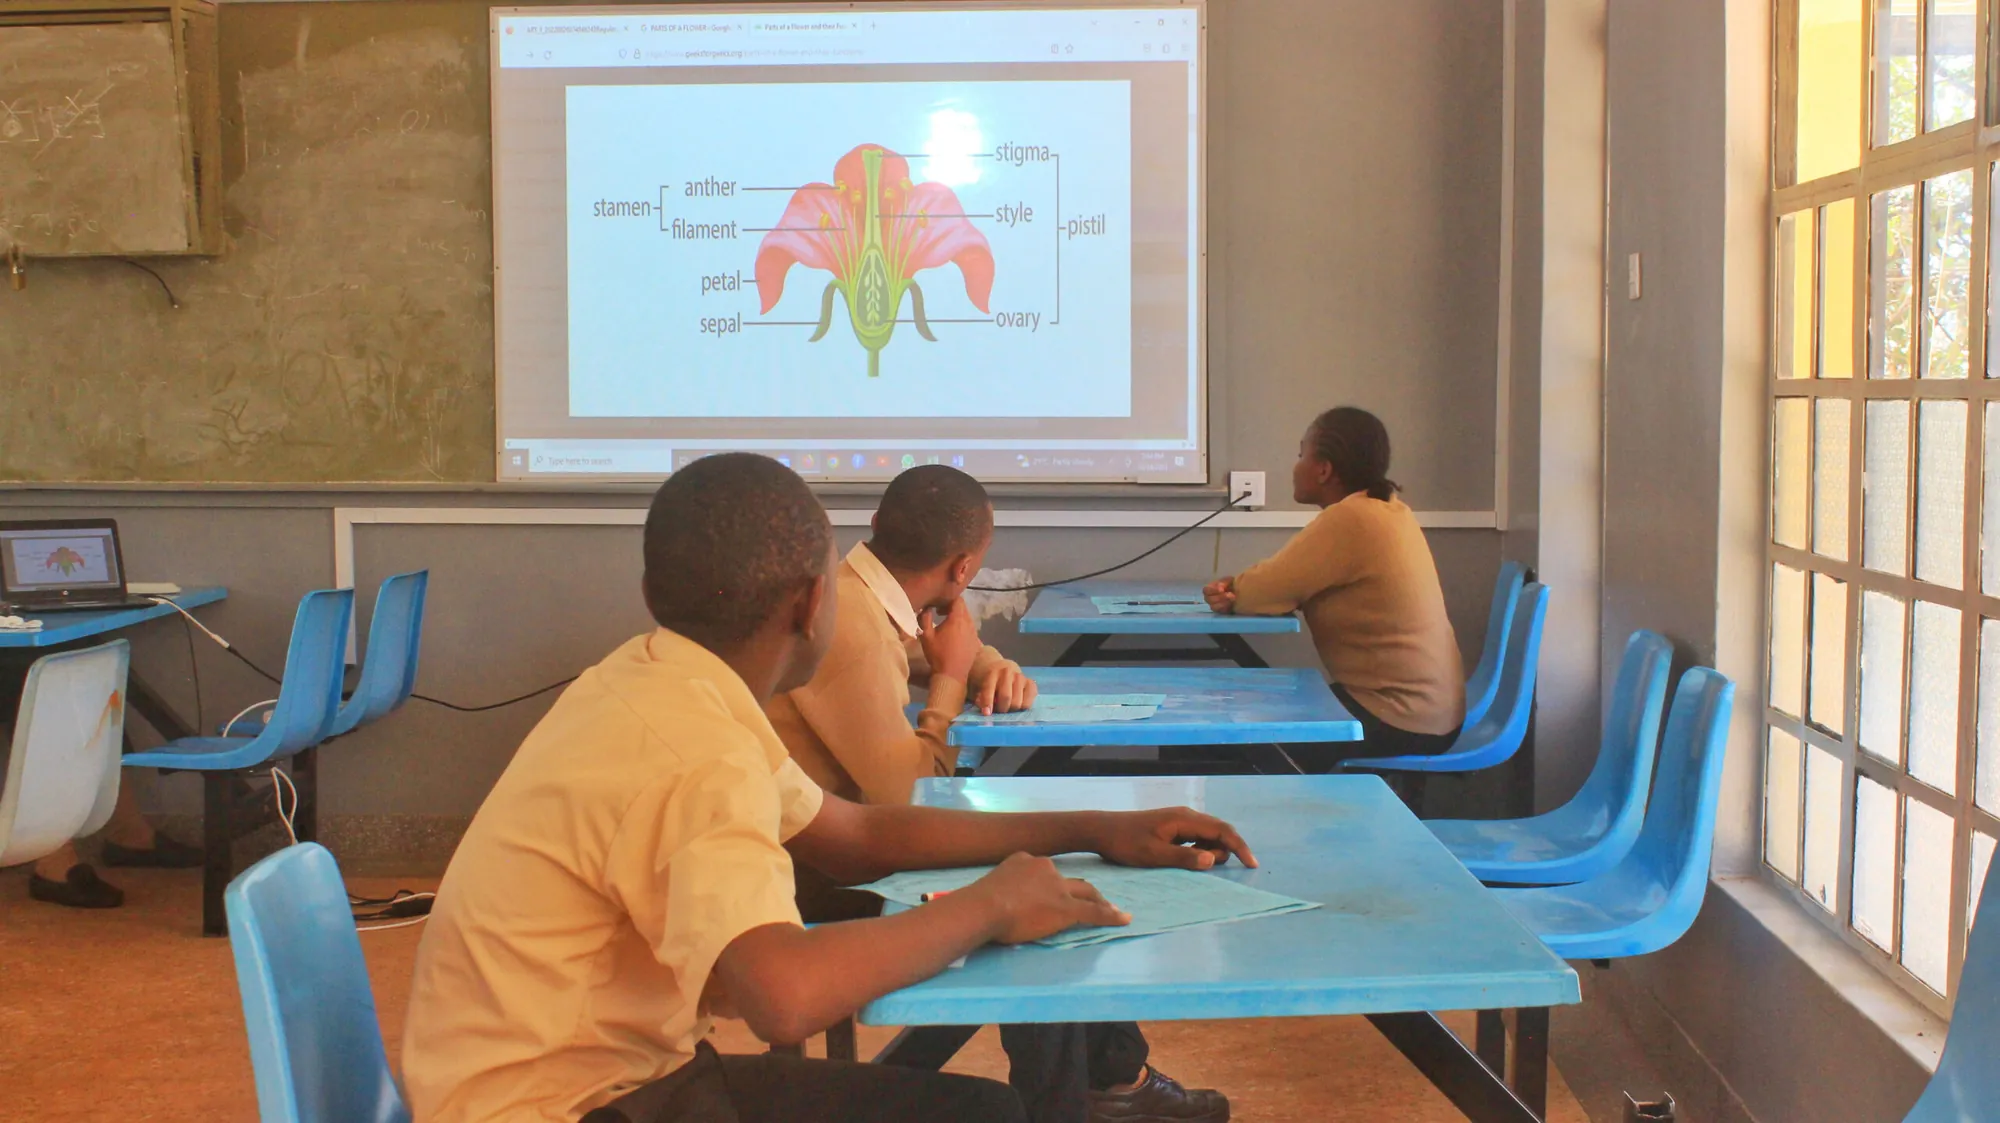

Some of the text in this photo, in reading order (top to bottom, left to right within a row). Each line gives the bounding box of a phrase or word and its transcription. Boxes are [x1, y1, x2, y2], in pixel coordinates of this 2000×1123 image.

[995, 141, 1050, 167] stigma
[684, 176, 737, 197] anther
[593, 198, 651, 217] stamen
[995, 201, 1034, 228] style
[671, 218, 737, 239] filament
[1067, 214, 1106, 240] pistil
[701, 269, 741, 296] petal
[700, 312, 741, 338] sepal
[995, 311, 1041, 333] ovary
[548, 456, 613, 467] Type here to search
